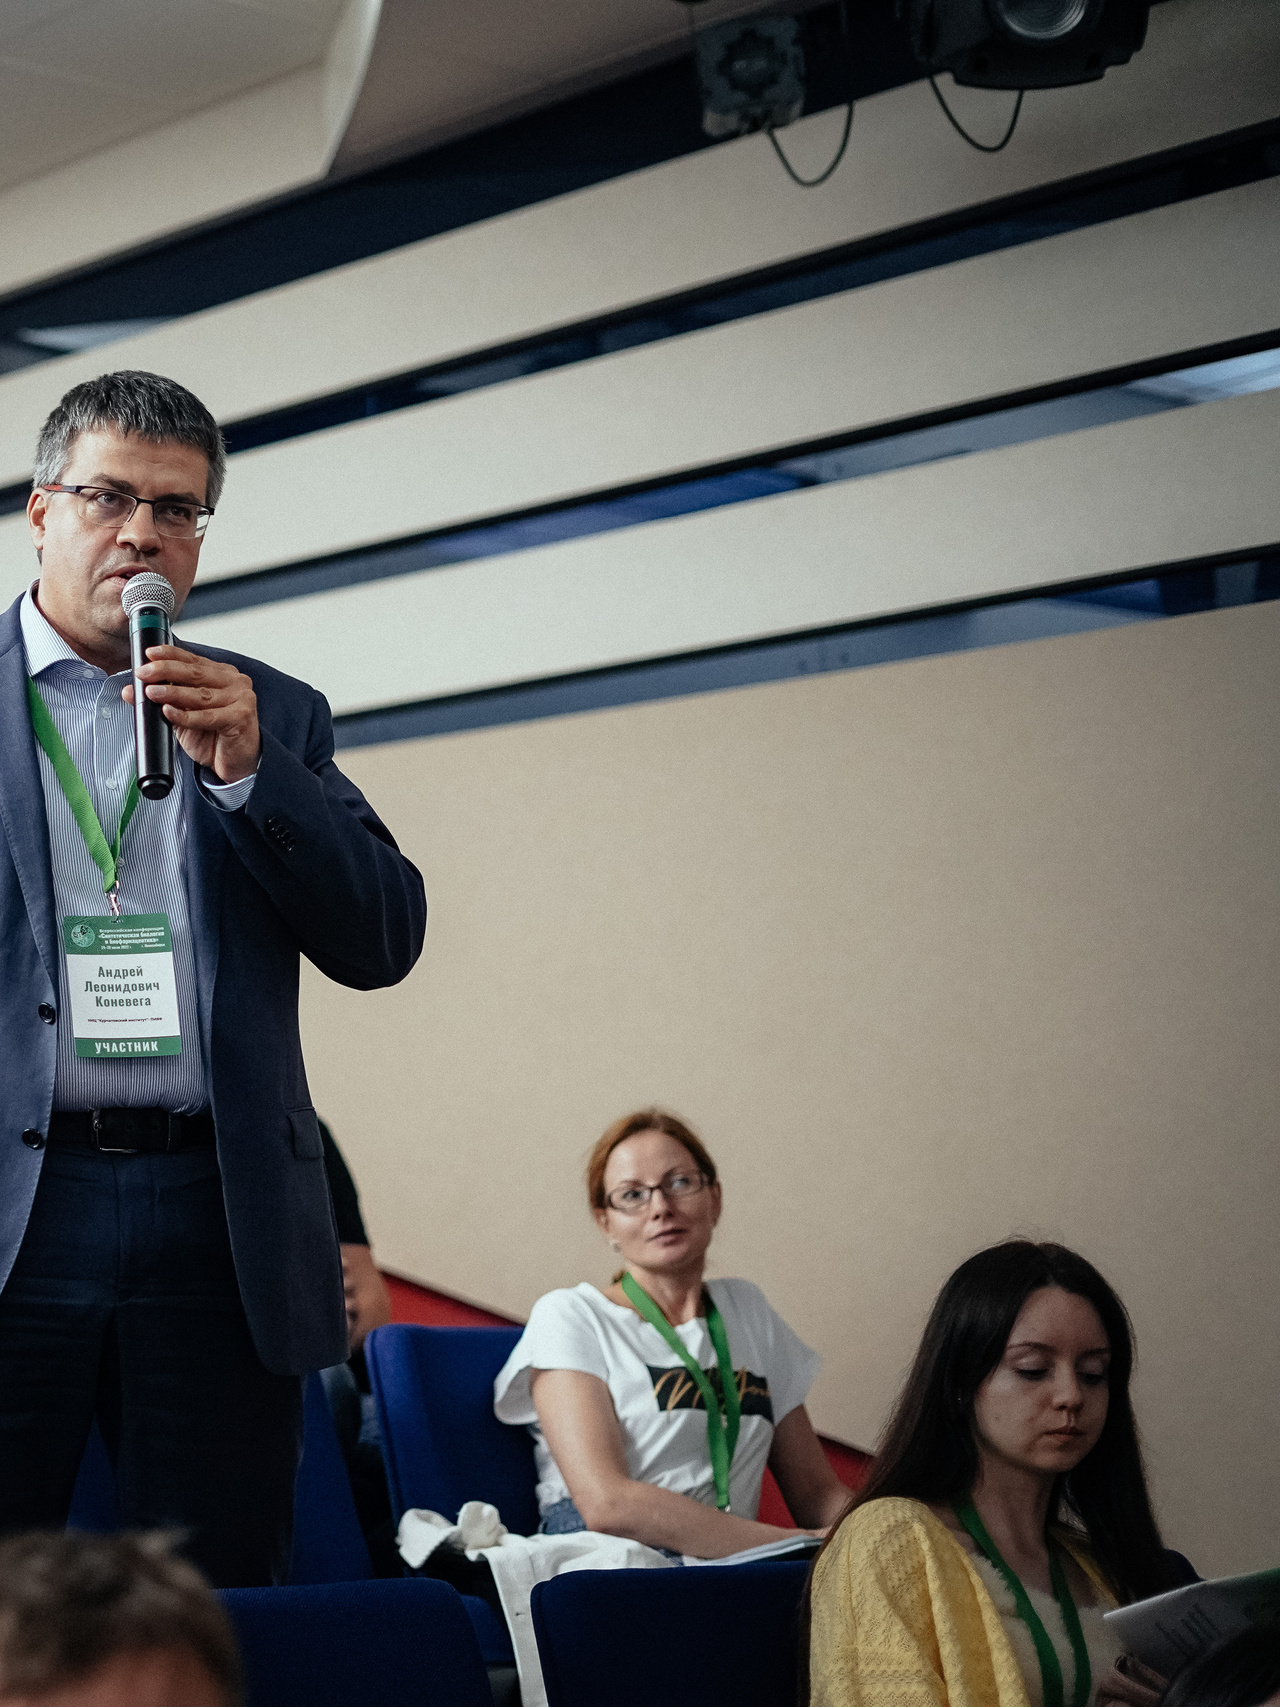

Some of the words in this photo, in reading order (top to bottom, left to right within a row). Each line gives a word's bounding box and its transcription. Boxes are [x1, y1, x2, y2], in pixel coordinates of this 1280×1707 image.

[98, 966, 144, 979] Андрей
[84, 981, 160, 994] Леонидович
[95, 995, 152, 1007] Коневега
[95, 1041, 159, 1054] УЧАСТНИК
